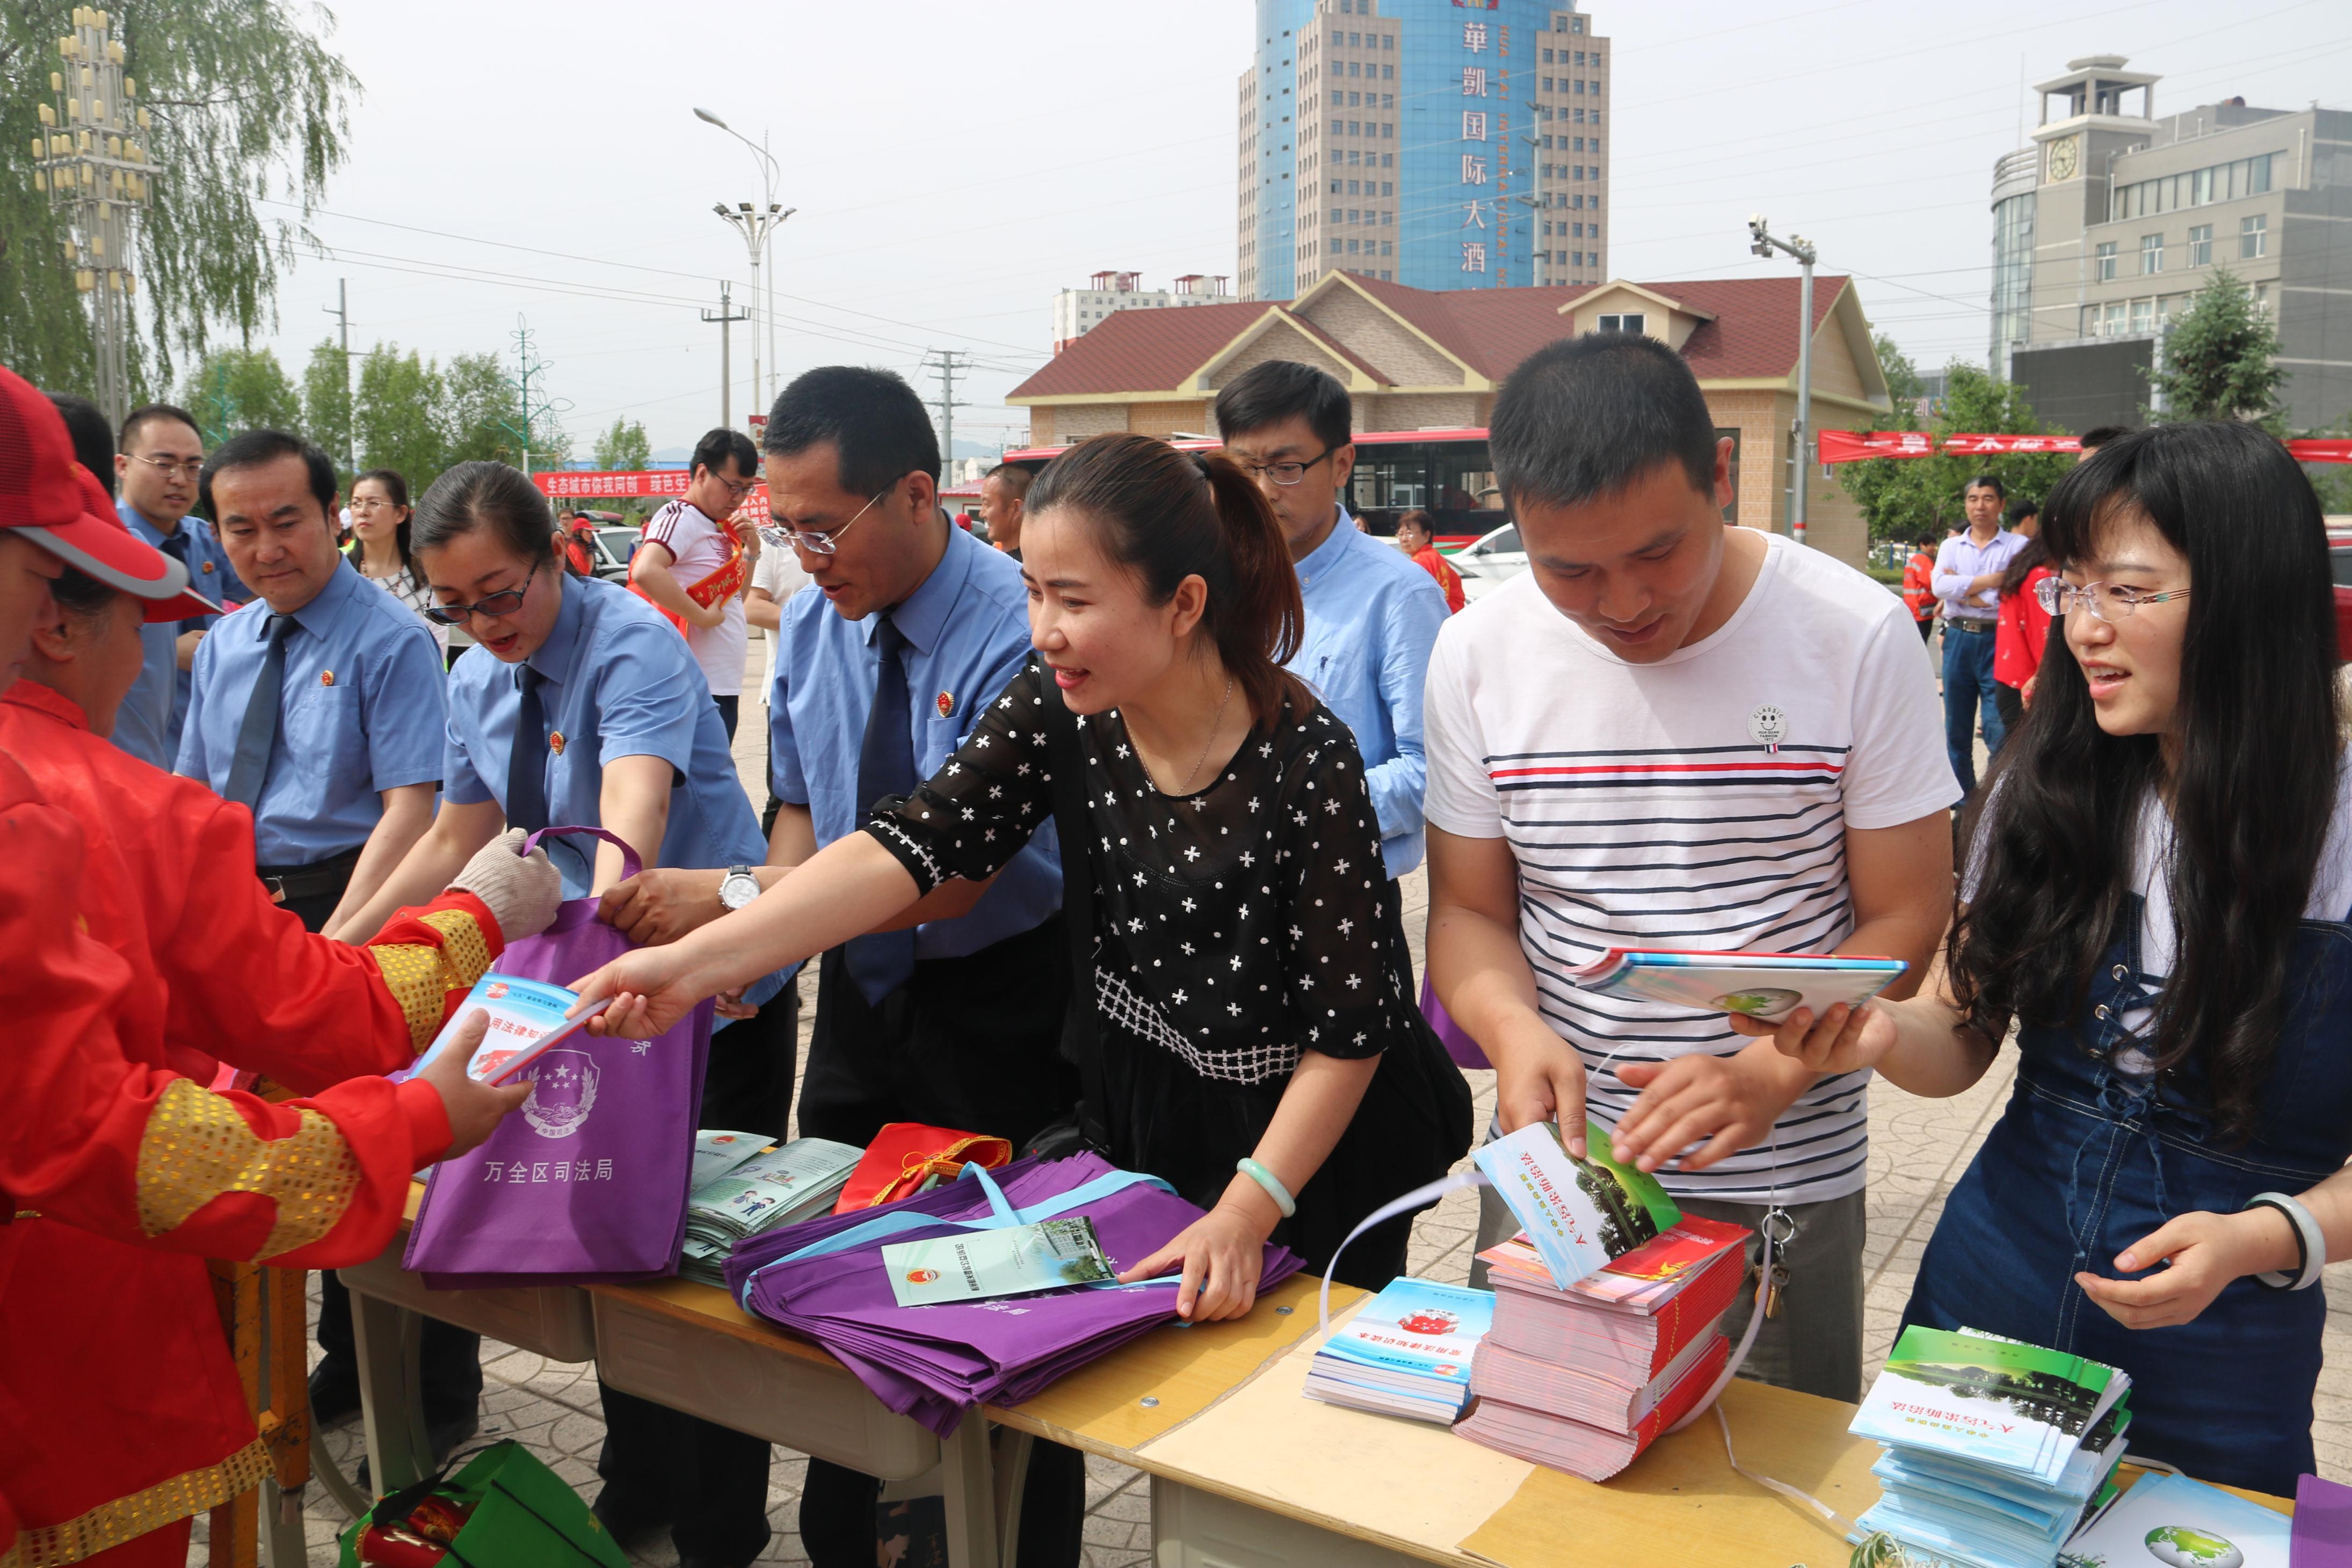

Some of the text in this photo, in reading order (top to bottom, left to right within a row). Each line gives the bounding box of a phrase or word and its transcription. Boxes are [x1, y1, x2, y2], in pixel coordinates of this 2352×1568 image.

[1498, 25, 1509, 57] HUA
[1460, 21, 1487, 290] 華凱国际大酒
[547, 474, 692, 494] 生态城市你我同创 绿色生
[1753, 707, 1783, 718] CLASSIC
[484, 1158, 613, 1184] 万全区司法局
[1519, 1150, 1588, 1248] 大气污染防治法
[1519, 1173, 1564, 1237] 中华人民共和国
[1357, 1332, 1463, 1356] 常用法律知识读本
[1890, 1400, 2015, 1433] 大气污染防治法
[1905, 1417, 1988, 1439] 中华人民共和国
